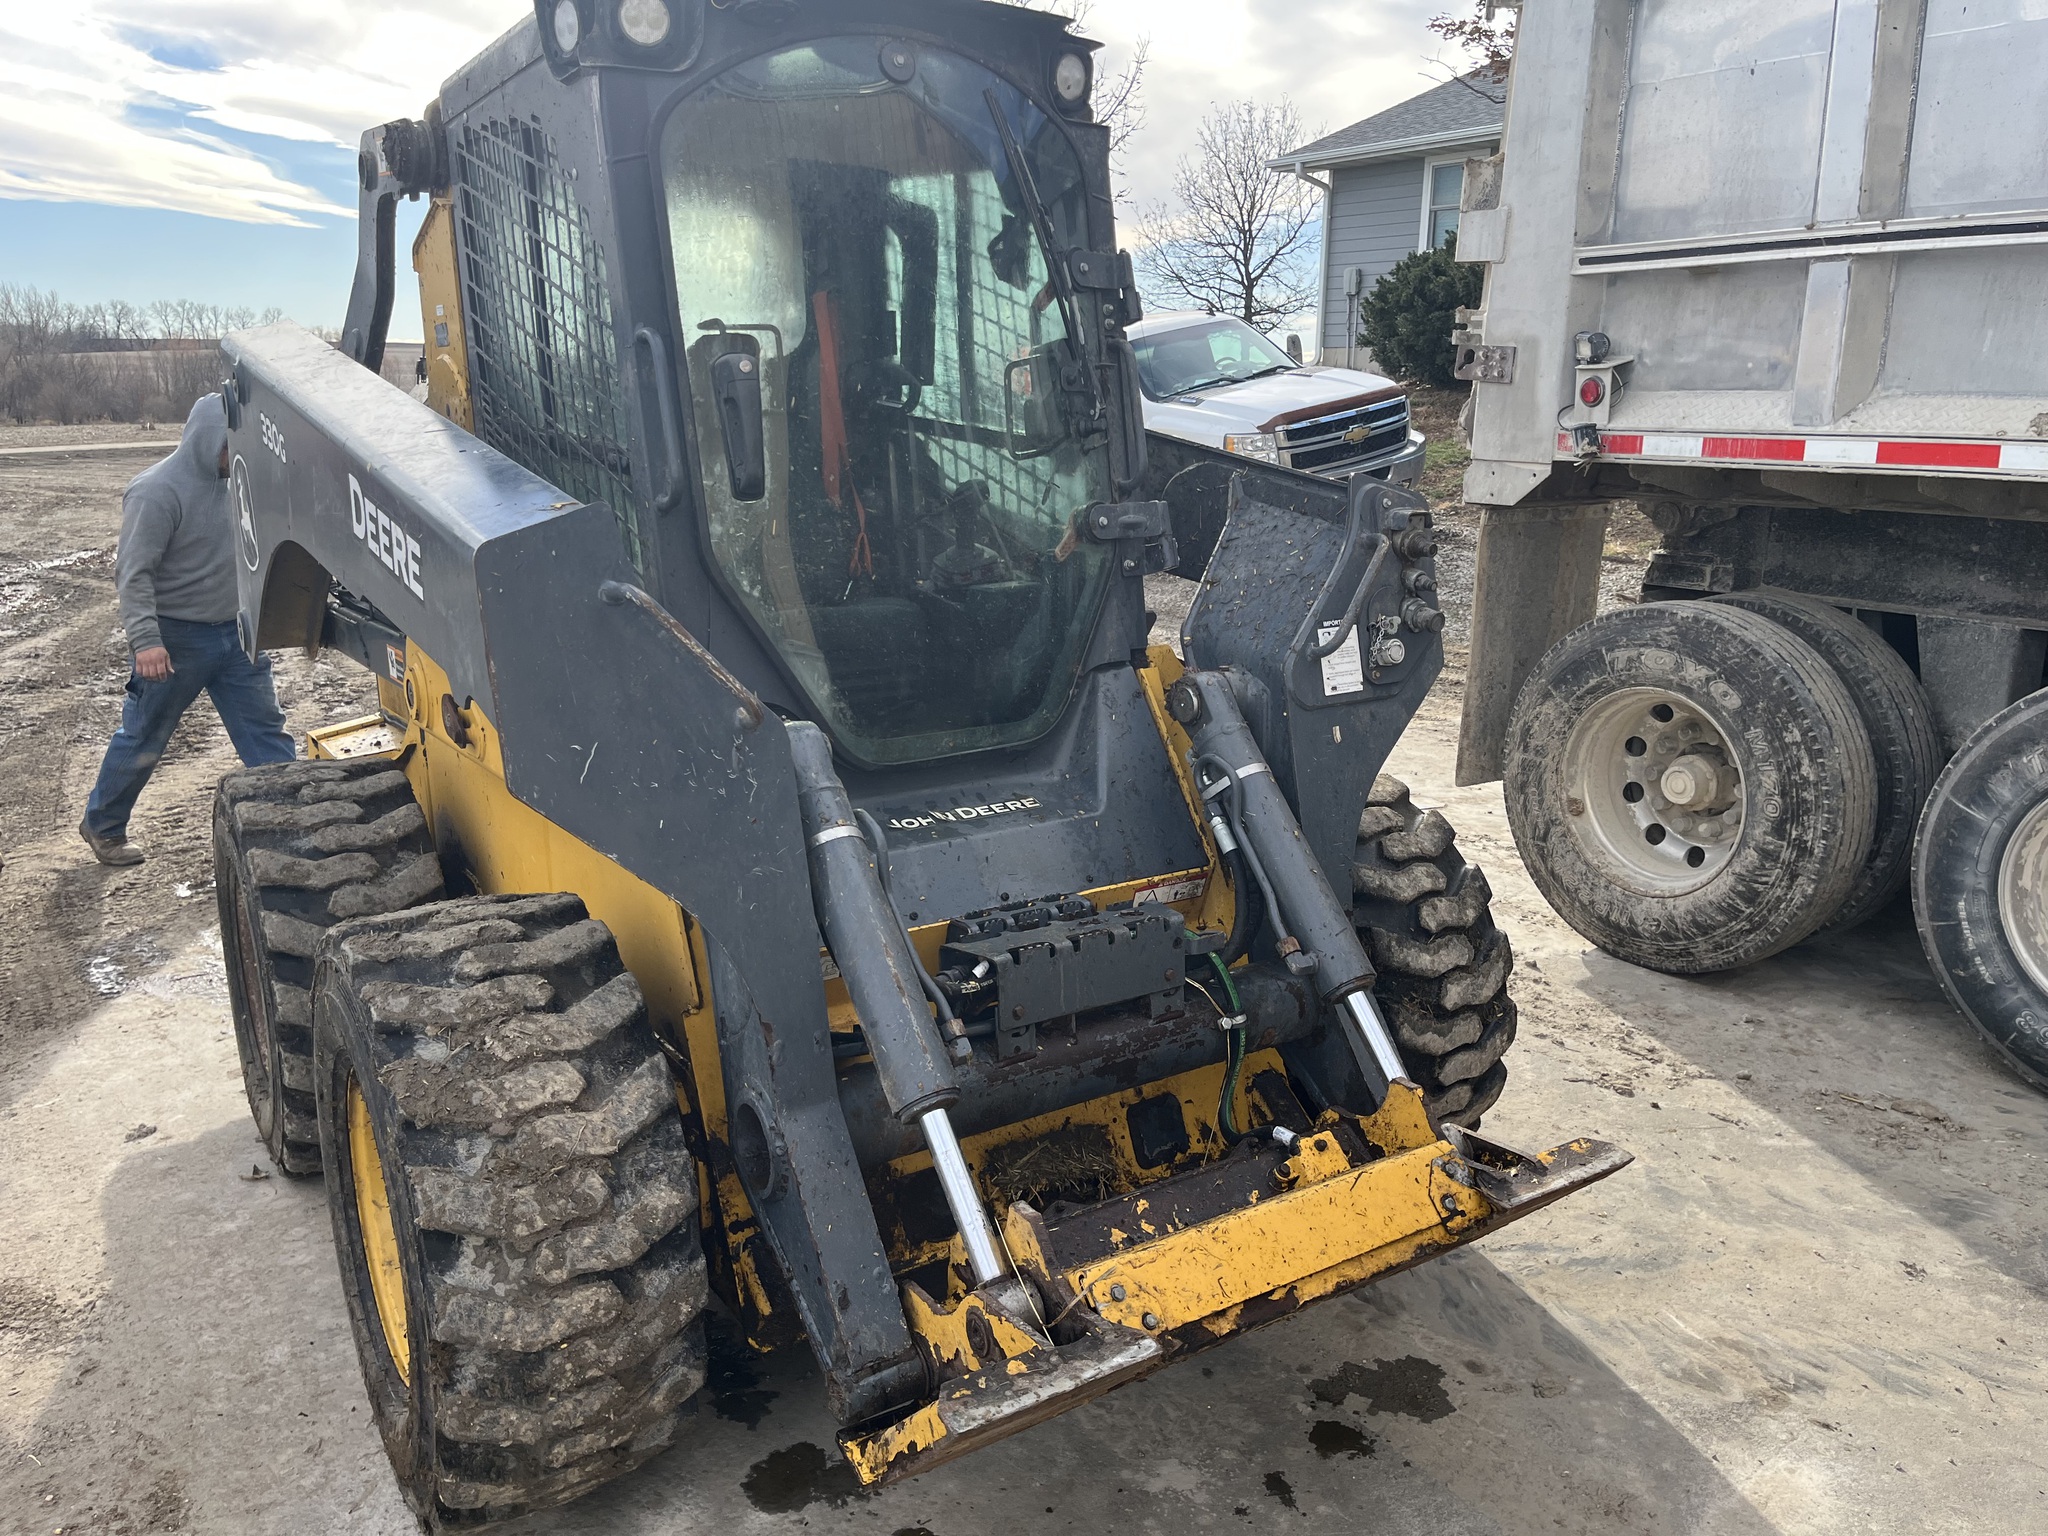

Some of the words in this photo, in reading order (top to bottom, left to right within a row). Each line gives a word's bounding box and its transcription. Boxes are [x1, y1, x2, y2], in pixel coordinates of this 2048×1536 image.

[260, 412, 287, 464] 330G
[349, 472, 424, 600] DEERE
[1322, 619, 1344, 628] IMPORT
[1608, 648, 1743, 710] TOYO
[1744, 726, 1781, 818] M170
[887, 810, 956, 829] JOHN
[955, 797, 1041, 819] DEERE
